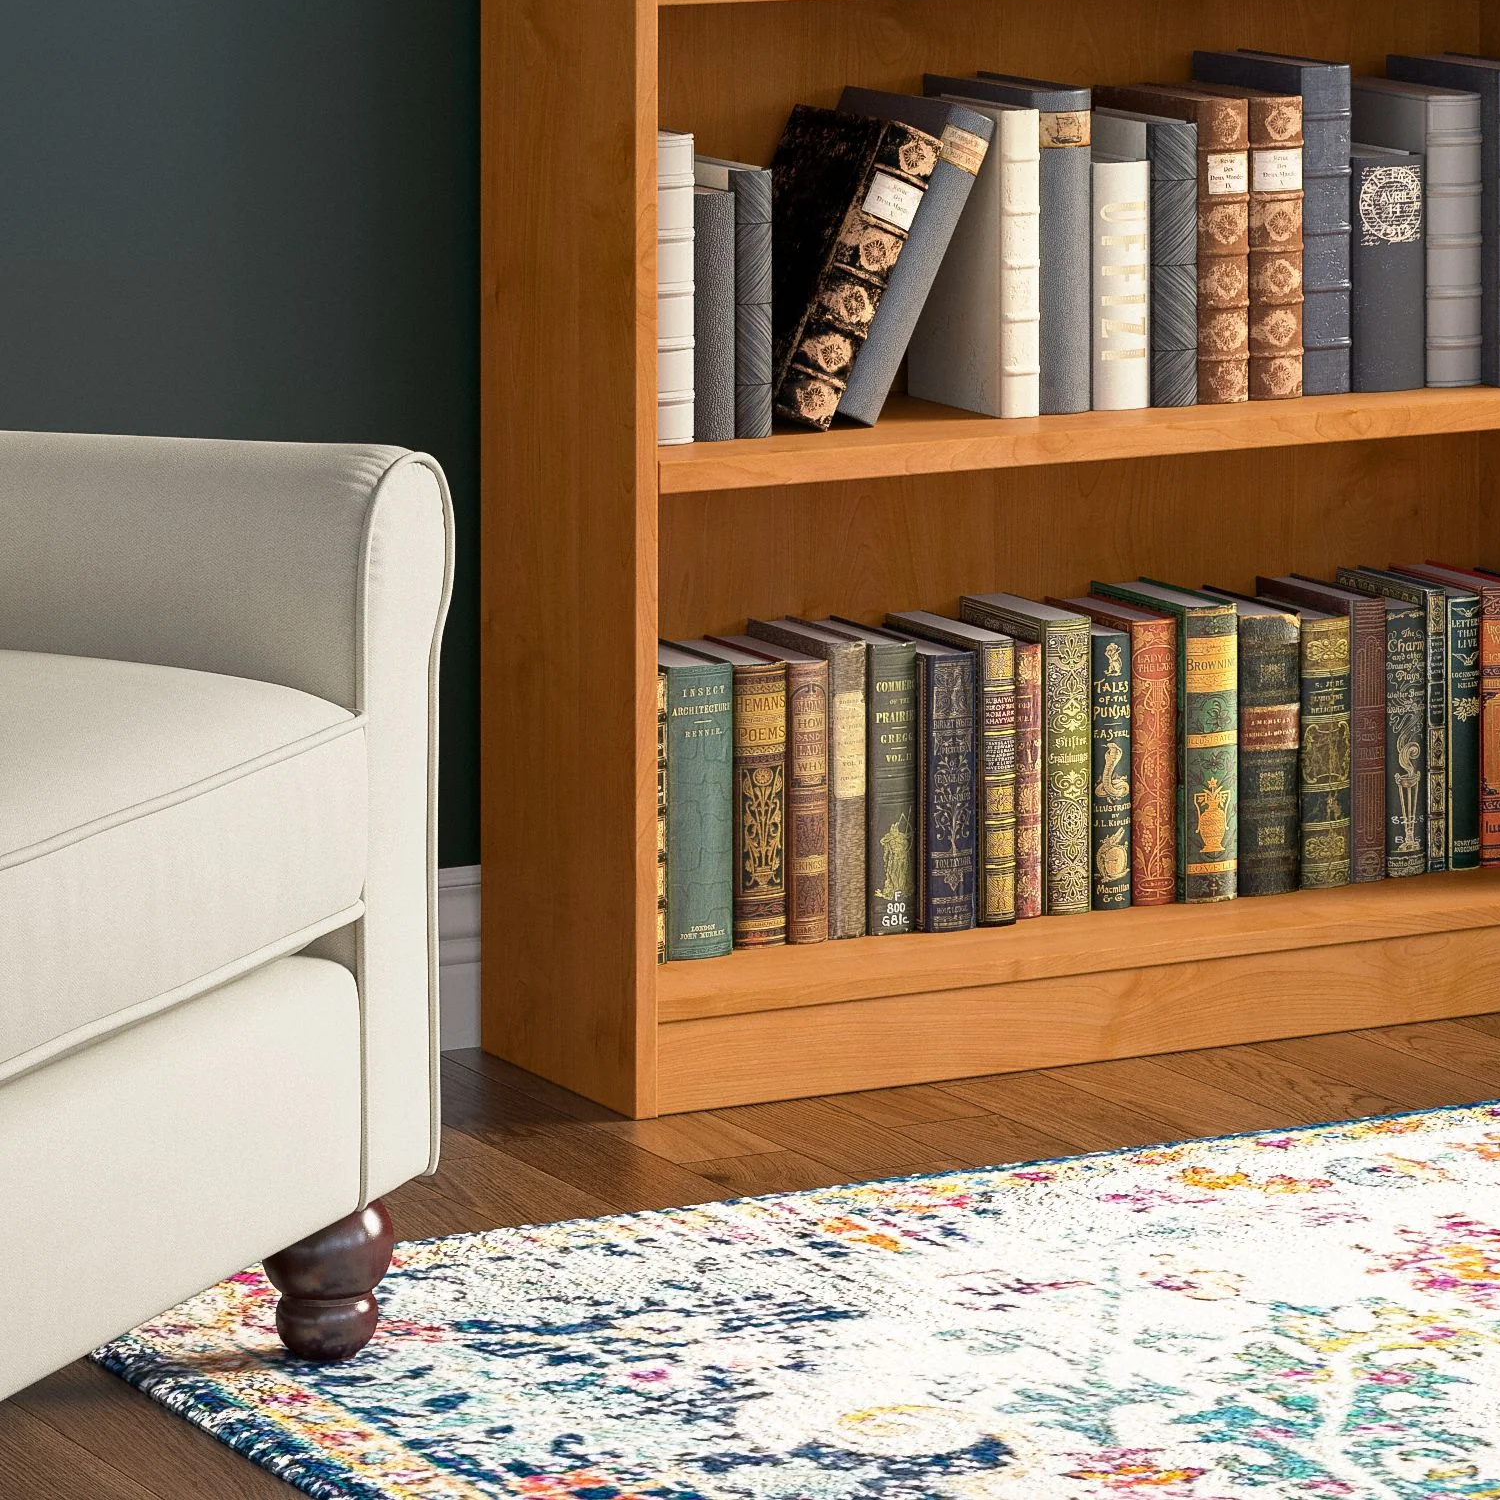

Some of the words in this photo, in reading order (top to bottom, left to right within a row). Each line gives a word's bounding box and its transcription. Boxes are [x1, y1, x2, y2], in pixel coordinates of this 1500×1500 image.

[1100, 200, 1146, 361] UFFIZI
[1400, 629, 1415, 638] The
[1457, 628, 1478, 638] THAT
[1387, 639, 1424, 653] Charm
[1457, 637, 1478, 649] LIVE
[1392, 653, 1406, 661] and
[1406, 652, 1423, 661] other
[1395, 670, 1421, 682] Plays
[682, 684, 725, 698] INSECT
[1094, 677, 1129, 693] TALES
[1457, 681, 1479, 689] KELLY
[736, 695, 785, 713] HEMANS
[1093, 705, 1131, 720] PUNJAB
[798, 718, 823, 729] HOW
[1250, 717, 1291, 726] AMERICAN
[738, 725, 785, 743] POEMS
[803, 733, 820, 741] AND
[1109, 728, 1130, 741] STEEL
[1273, 728, 1298, 738] BOTANY
[799, 744, 824, 756] LADY
[885, 754, 905, 763] VOL.
[798, 760, 824, 772] WHY
[934, 858, 951, 869] TOM
[951, 857, 971, 868] TAYLOR
[1189, 862, 1234, 874] LOVELL
[1096, 883, 1130, 895] Macmillan
[894, 891, 901, 902] F
[887, 902, 906, 914] 800
[690, 924, 716, 933] LONDON
[679, 931, 699, 940] JOHN
